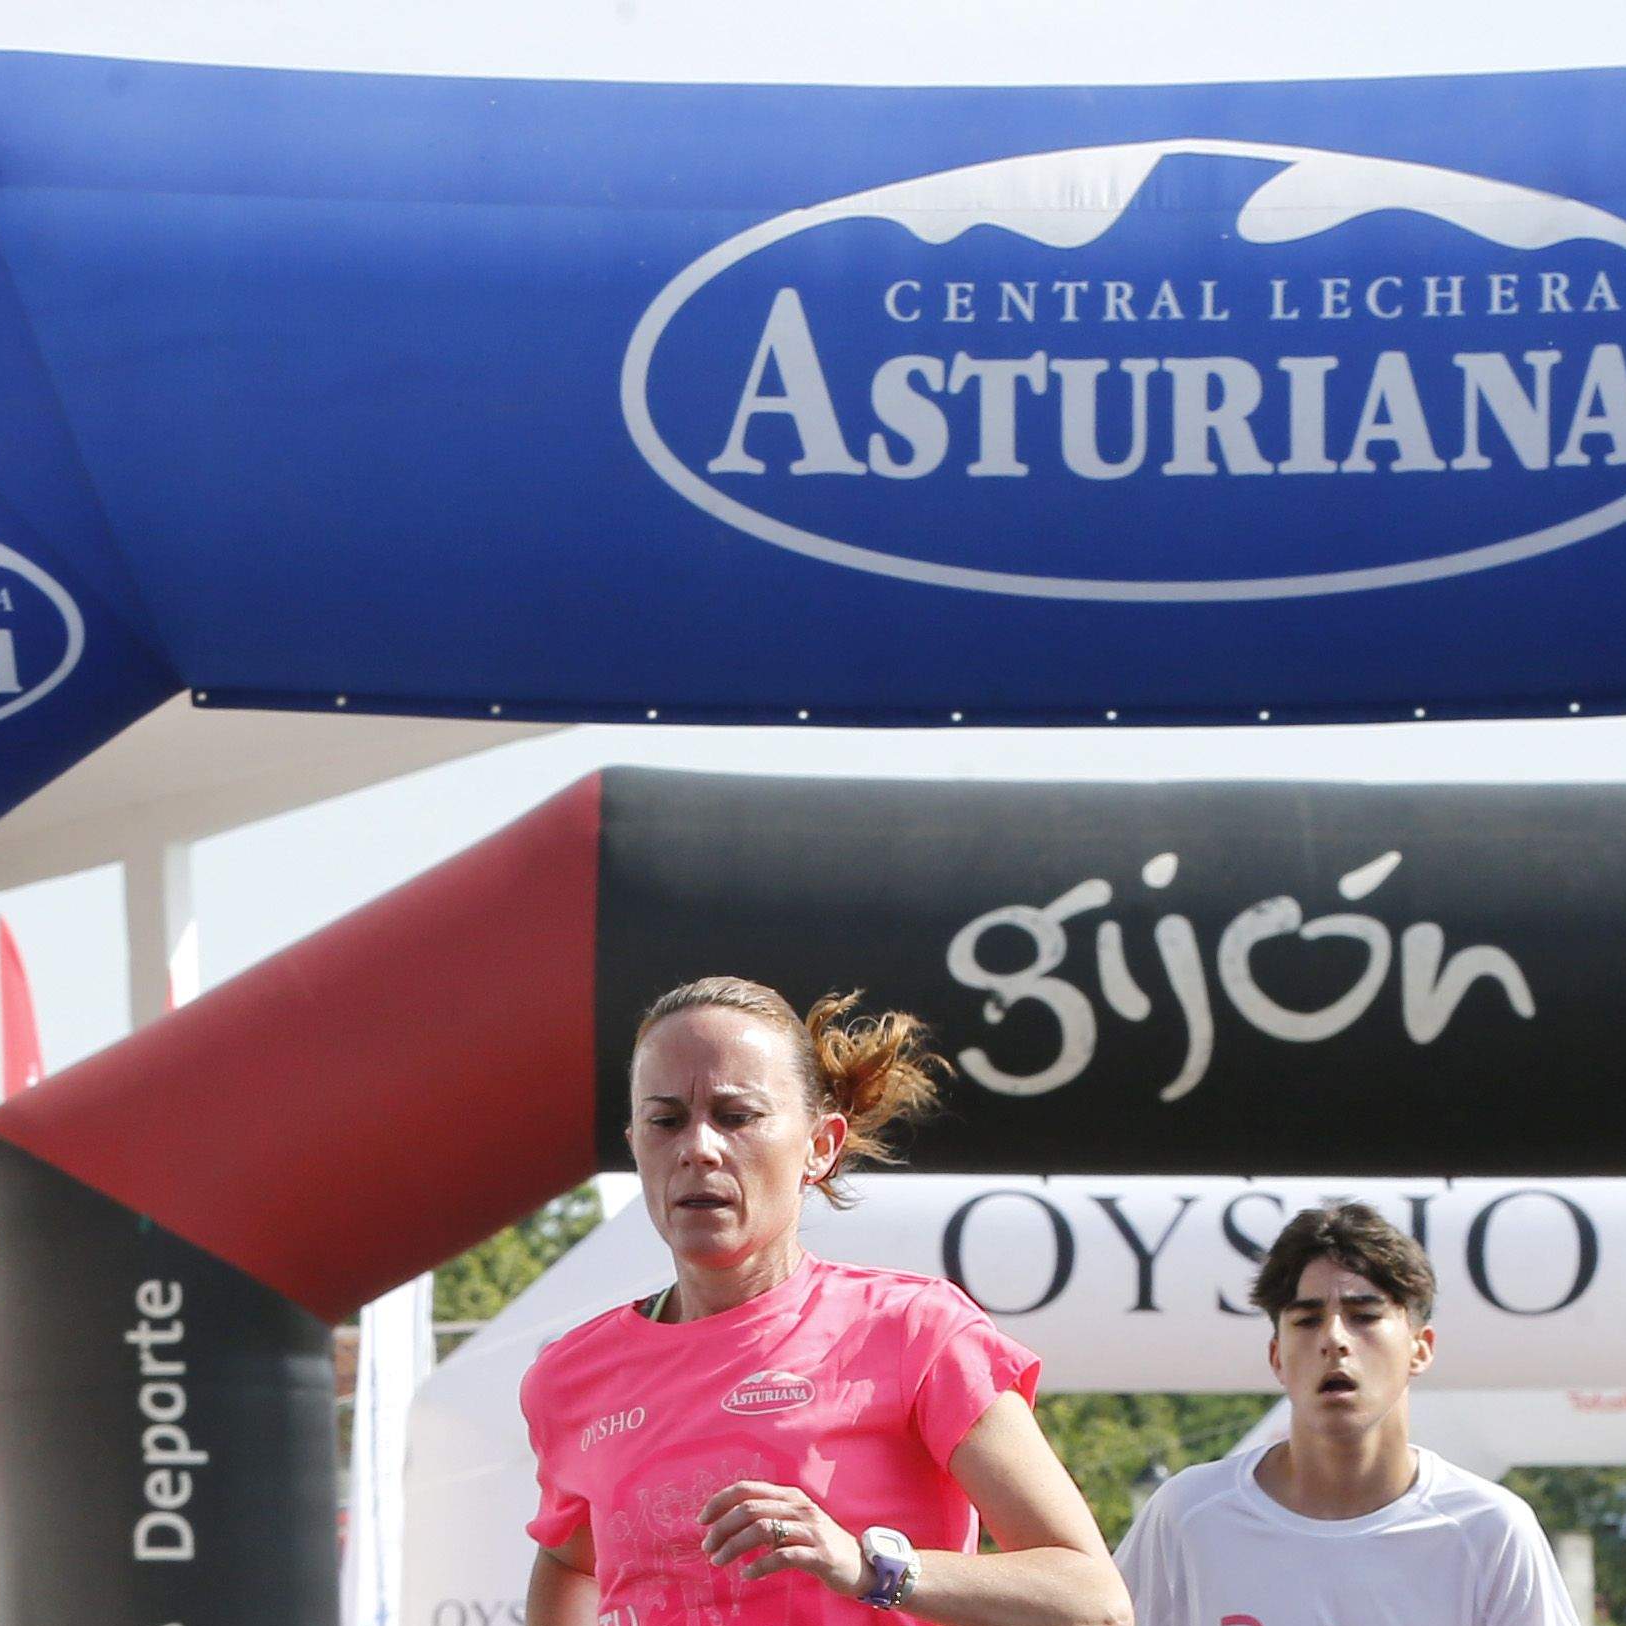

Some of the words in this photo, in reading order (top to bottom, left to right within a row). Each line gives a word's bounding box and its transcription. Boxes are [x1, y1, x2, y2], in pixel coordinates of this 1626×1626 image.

[885, 279, 1231, 325] CENTRAL
[1271, 271, 1623, 322] LECHERA
[946, 849, 1536, 1104] gijón
[124, 1278, 210, 1563] Deporte
[727, 1388, 808, 1408] ASTURIANA
[580, 1406, 646, 1452] OYSHO
